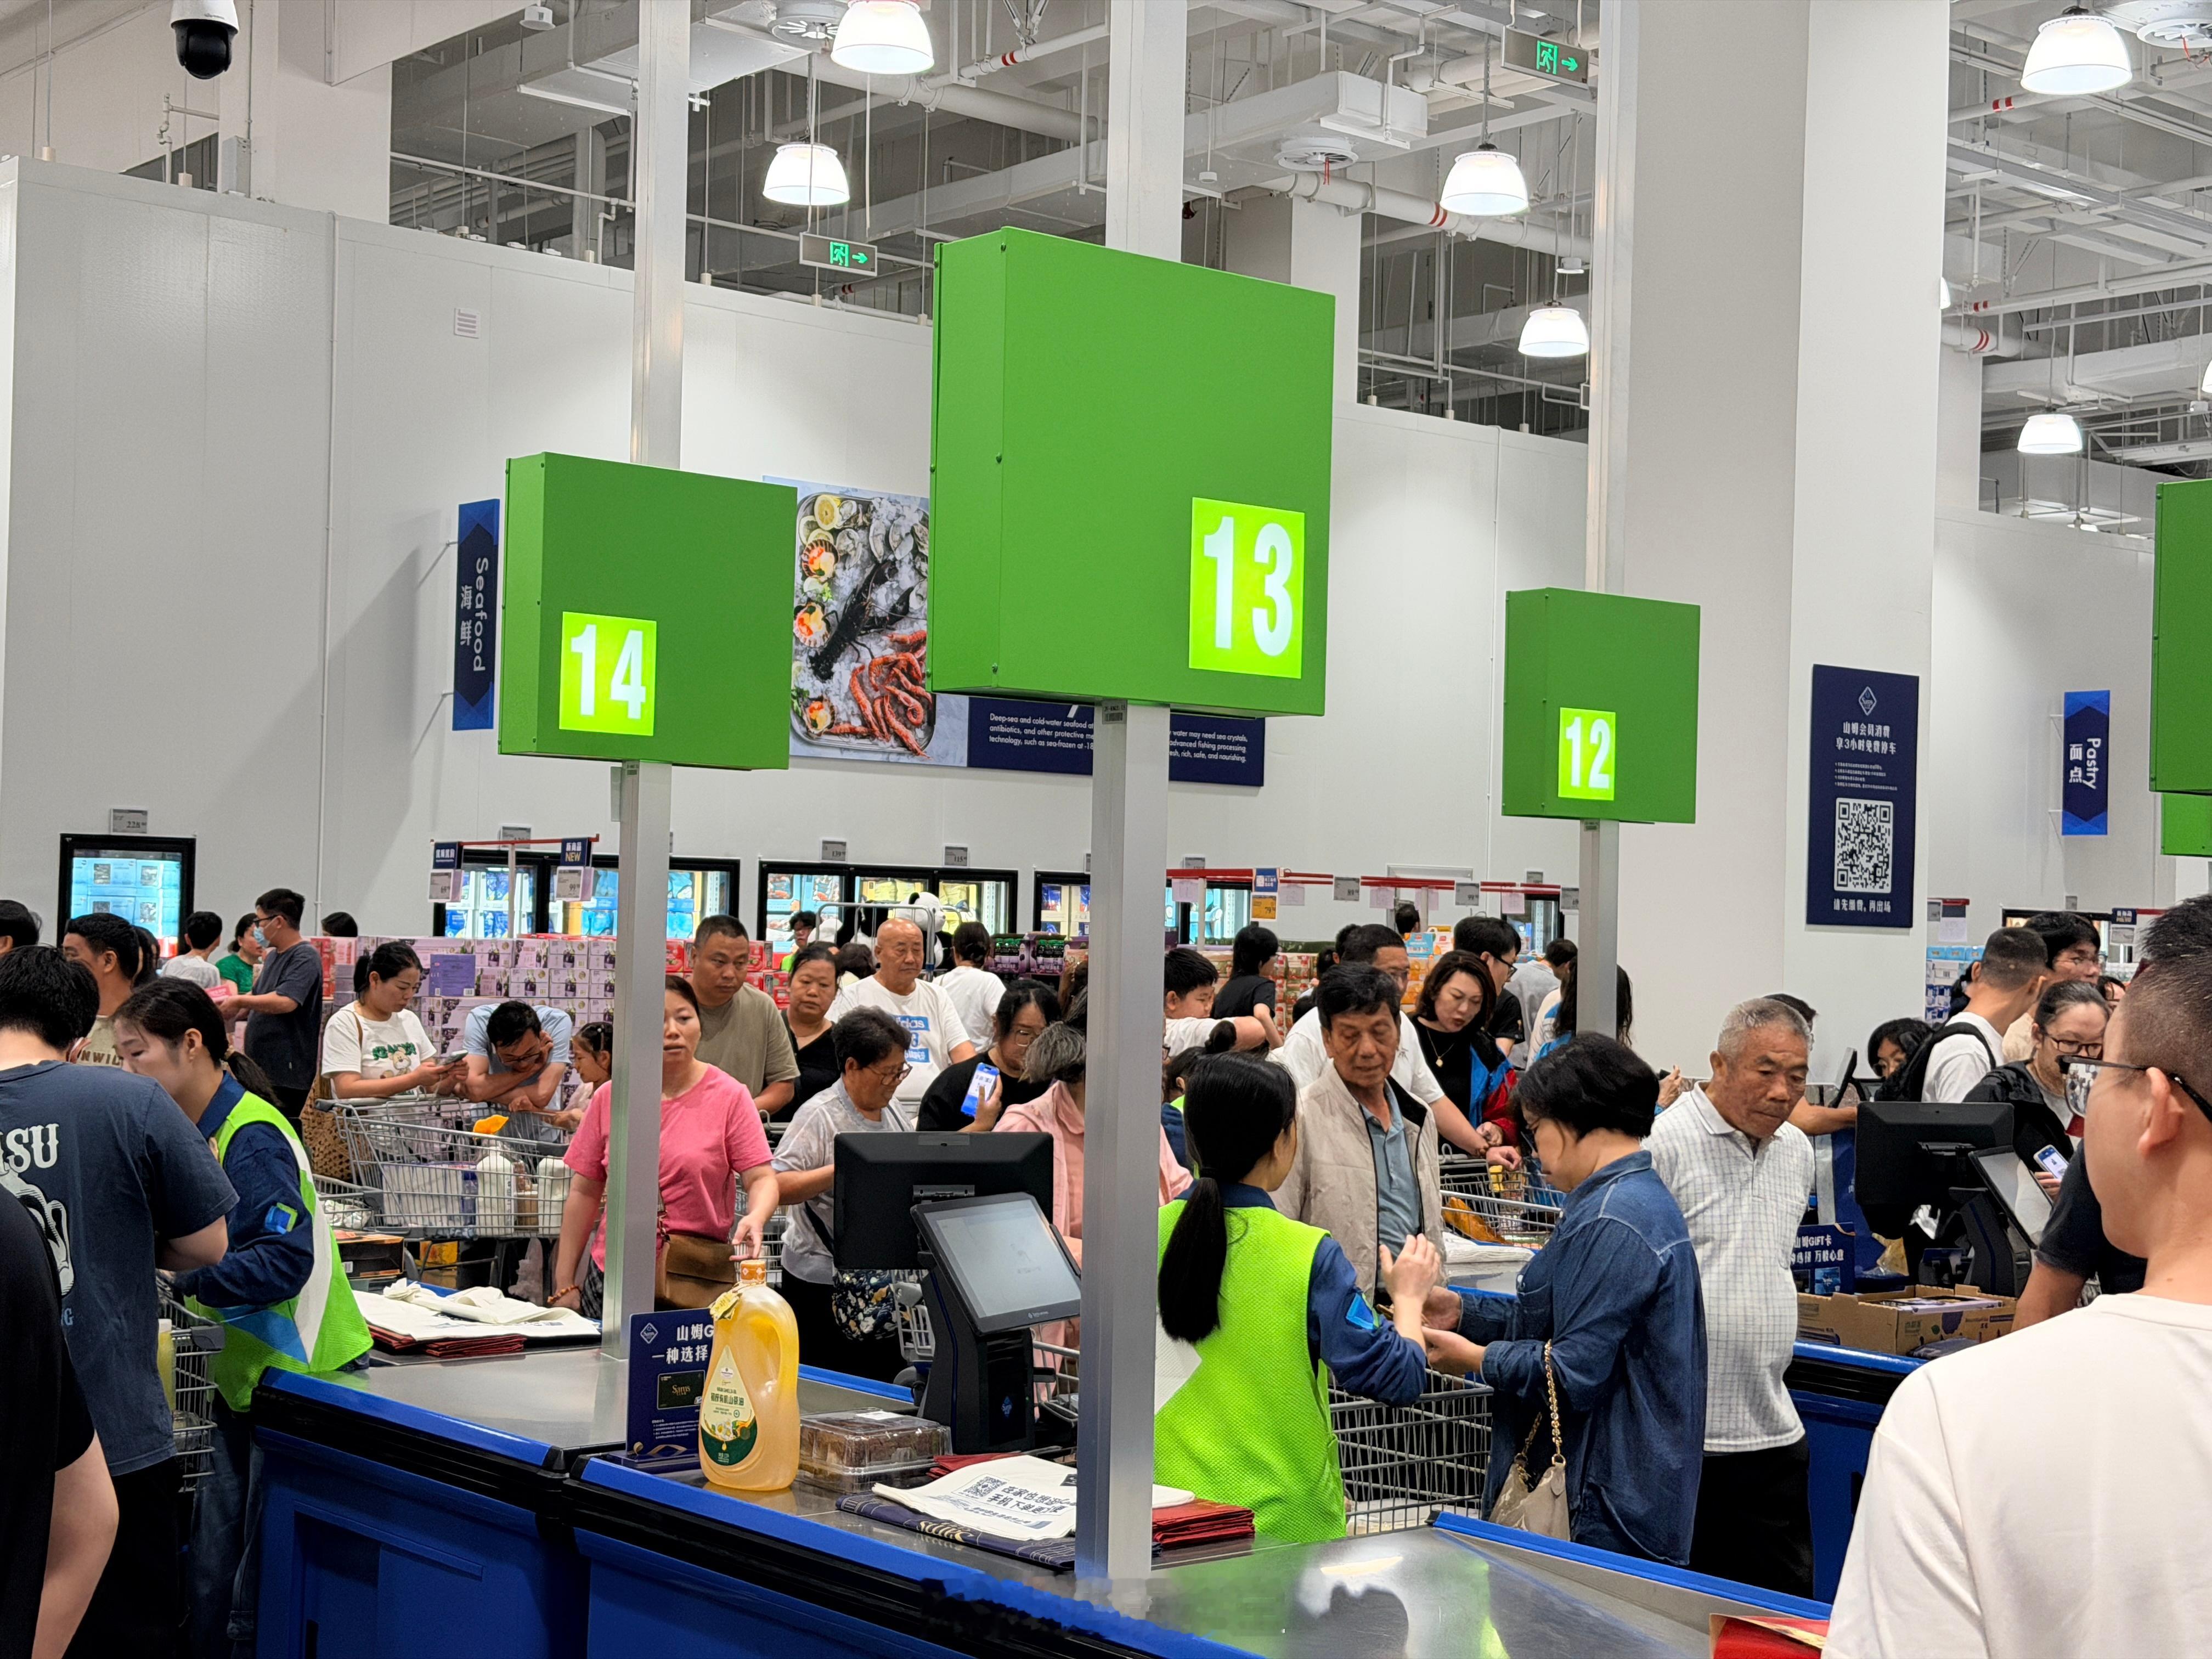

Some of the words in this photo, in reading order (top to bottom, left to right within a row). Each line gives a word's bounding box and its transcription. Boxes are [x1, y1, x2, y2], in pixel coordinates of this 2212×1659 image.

[1204, 516, 1293, 657] 13
[460, 585, 472, 646] 海鲜
[473, 557, 488, 672] Seafood
[571, 623, 646, 720] 14
[990, 713, 1019, 724] Deep-sea
[1032, 717, 1062, 726] cold-water
[1063, 719, 1087, 729] seafood
[1843, 721, 1891, 738] 山姆会员消费
[989, 724, 1022, 735] antibiotics,
[1023, 727, 1036, 735] and
[1037, 727, 1053, 736] other
[1054, 730, 1084, 739] protective
[1024, 737, 1037, 746] such
[1046, 740, 1076, 749] sea-frozen
[1170, 739, 1197, 748] advanced
[1198, 741, 1216, 751] fishing
[1565, 716, 1611, 789] 12
[1836, 736, 1897, 755] 享3小时免费停车
[2069, 743, 2083, 783] 面点
[2083, 738, 2102, 790] Pastry
[565, 851, 581, 862] NEW
[676, 1323, 714, 1341] 山姆G
[651, 1344, 708, 1364] 一种选择
